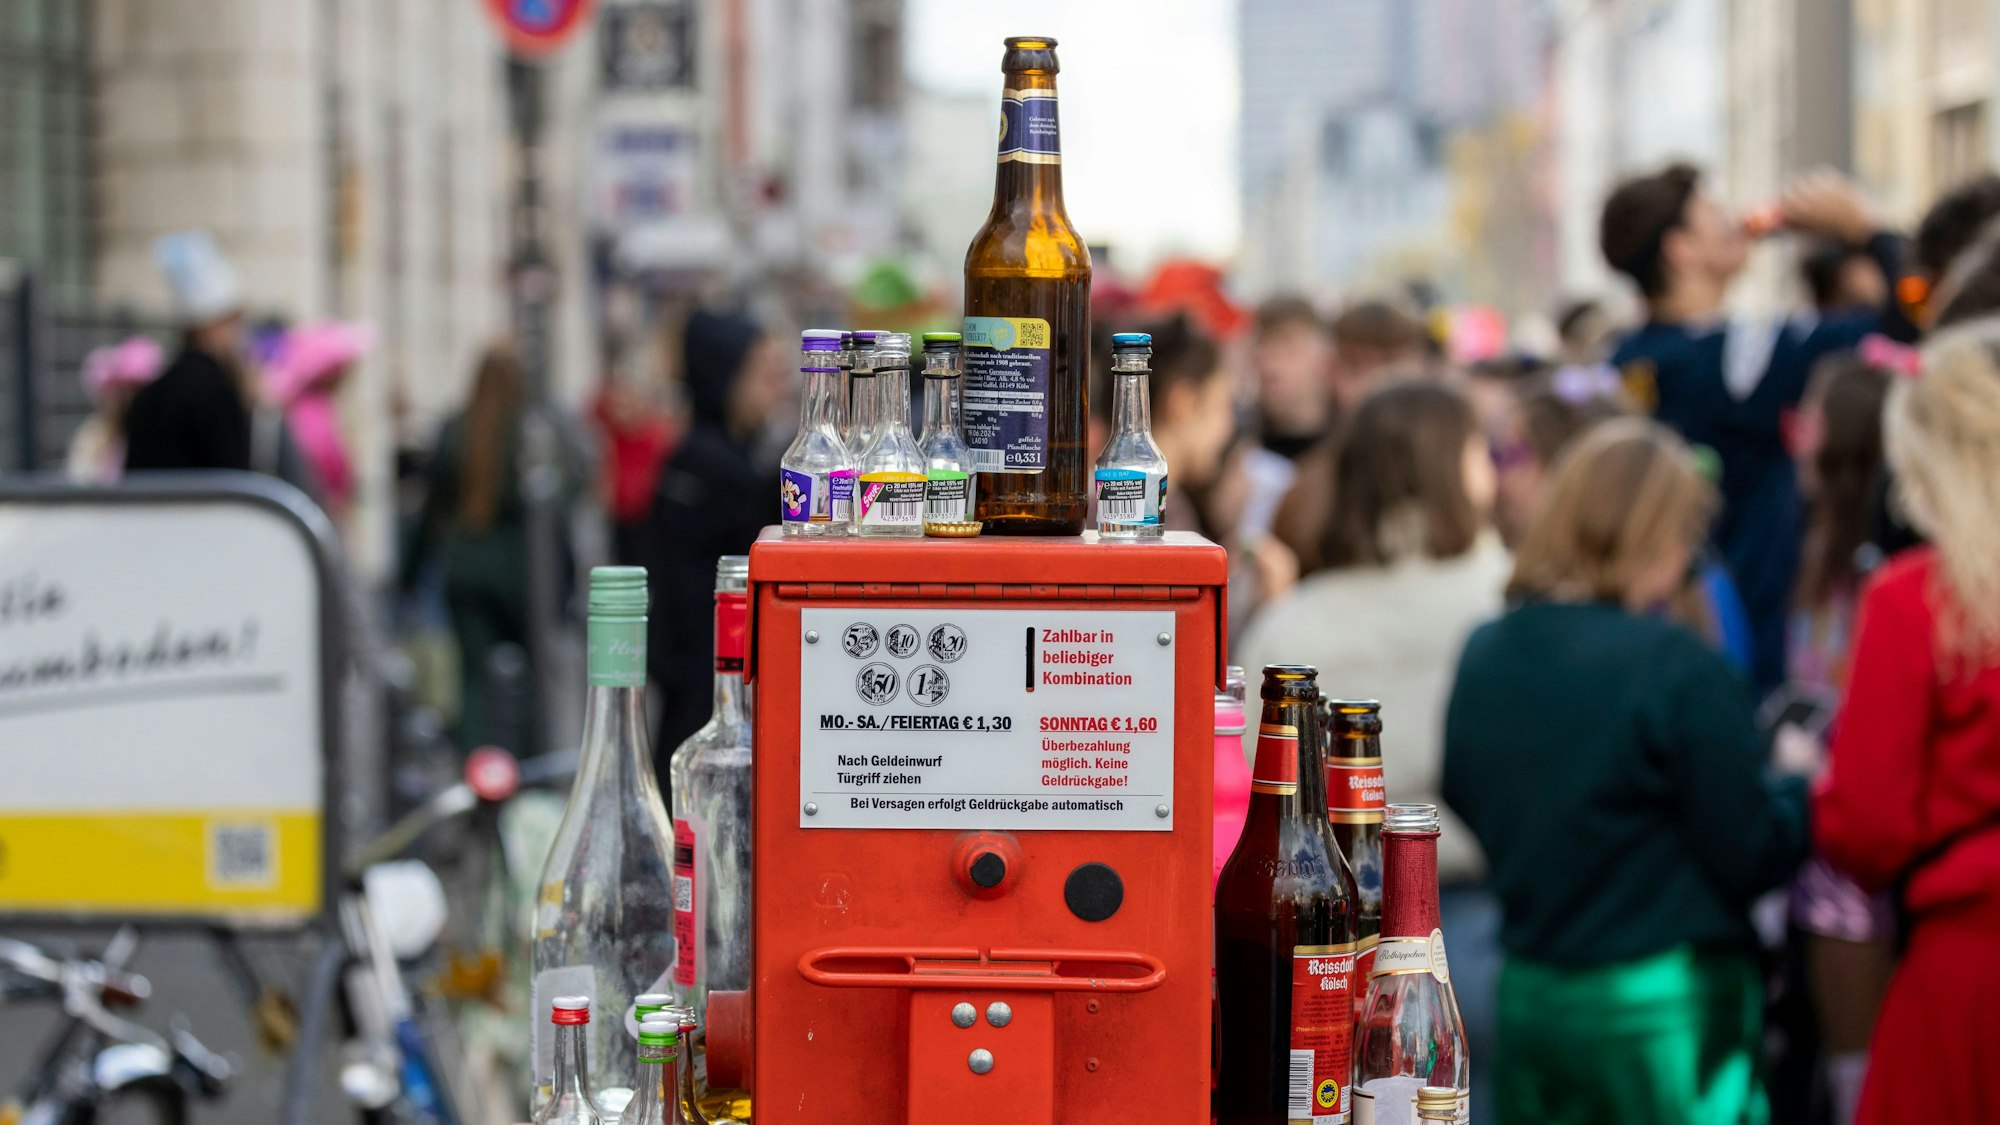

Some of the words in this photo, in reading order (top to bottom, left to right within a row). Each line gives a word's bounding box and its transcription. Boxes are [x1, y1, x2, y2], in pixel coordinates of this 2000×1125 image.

[1015, 452, 1035, 463] 0,33
[846, 628, 861, 648] 5
[901, 633, 914, 648] 10
[944, 635, 964, 652] 20
[1042, 629, 1097, 644] Zahlbar
[1101, 630, 1114, 644] in
[1042, 650, 1114, 667] beliebiger
[872, 673, 895, 694] 50
[914, 673, 926, 696] 1
[1042, 672, 1132, 686] Kombination
[963, 717, 973, 730] €
[977, 717, 1012, 732] 1,30
[1040, 717, 1108, 731] SONNTAG
[1111, 717, 1121, 730] €
[1125, 717, 1157, 732] 1,60
[1042, 738, 1131, 754] Überbezahlung
[838, 755, 868, 767] Nach
[871, 755, 943, 767] Geldeinwurf
[1042, 757, 1092, 771] möglich.
[1096, 758, 1129, 770] Keine
[837, 772, 881, 786] Türgriff
[883, 773, 921, 785] ziehen
[1042, 775, 1128, 789] Geldrückgabe!
[851, 798, 869, 809] Bei
[872, 798, 925, 811] Versagen
[928, 798, 966, 813] erfolgt
[969, 799, 1048, 813] Geldrückgabe
[1052, 800, 1123, 811] automatisch
[1379, 948, 1426, 962] Rotkäppchen
[1308, 956, 1355, 975] Reissdorf
[1320, 976, 1348, 991] Kölsch
